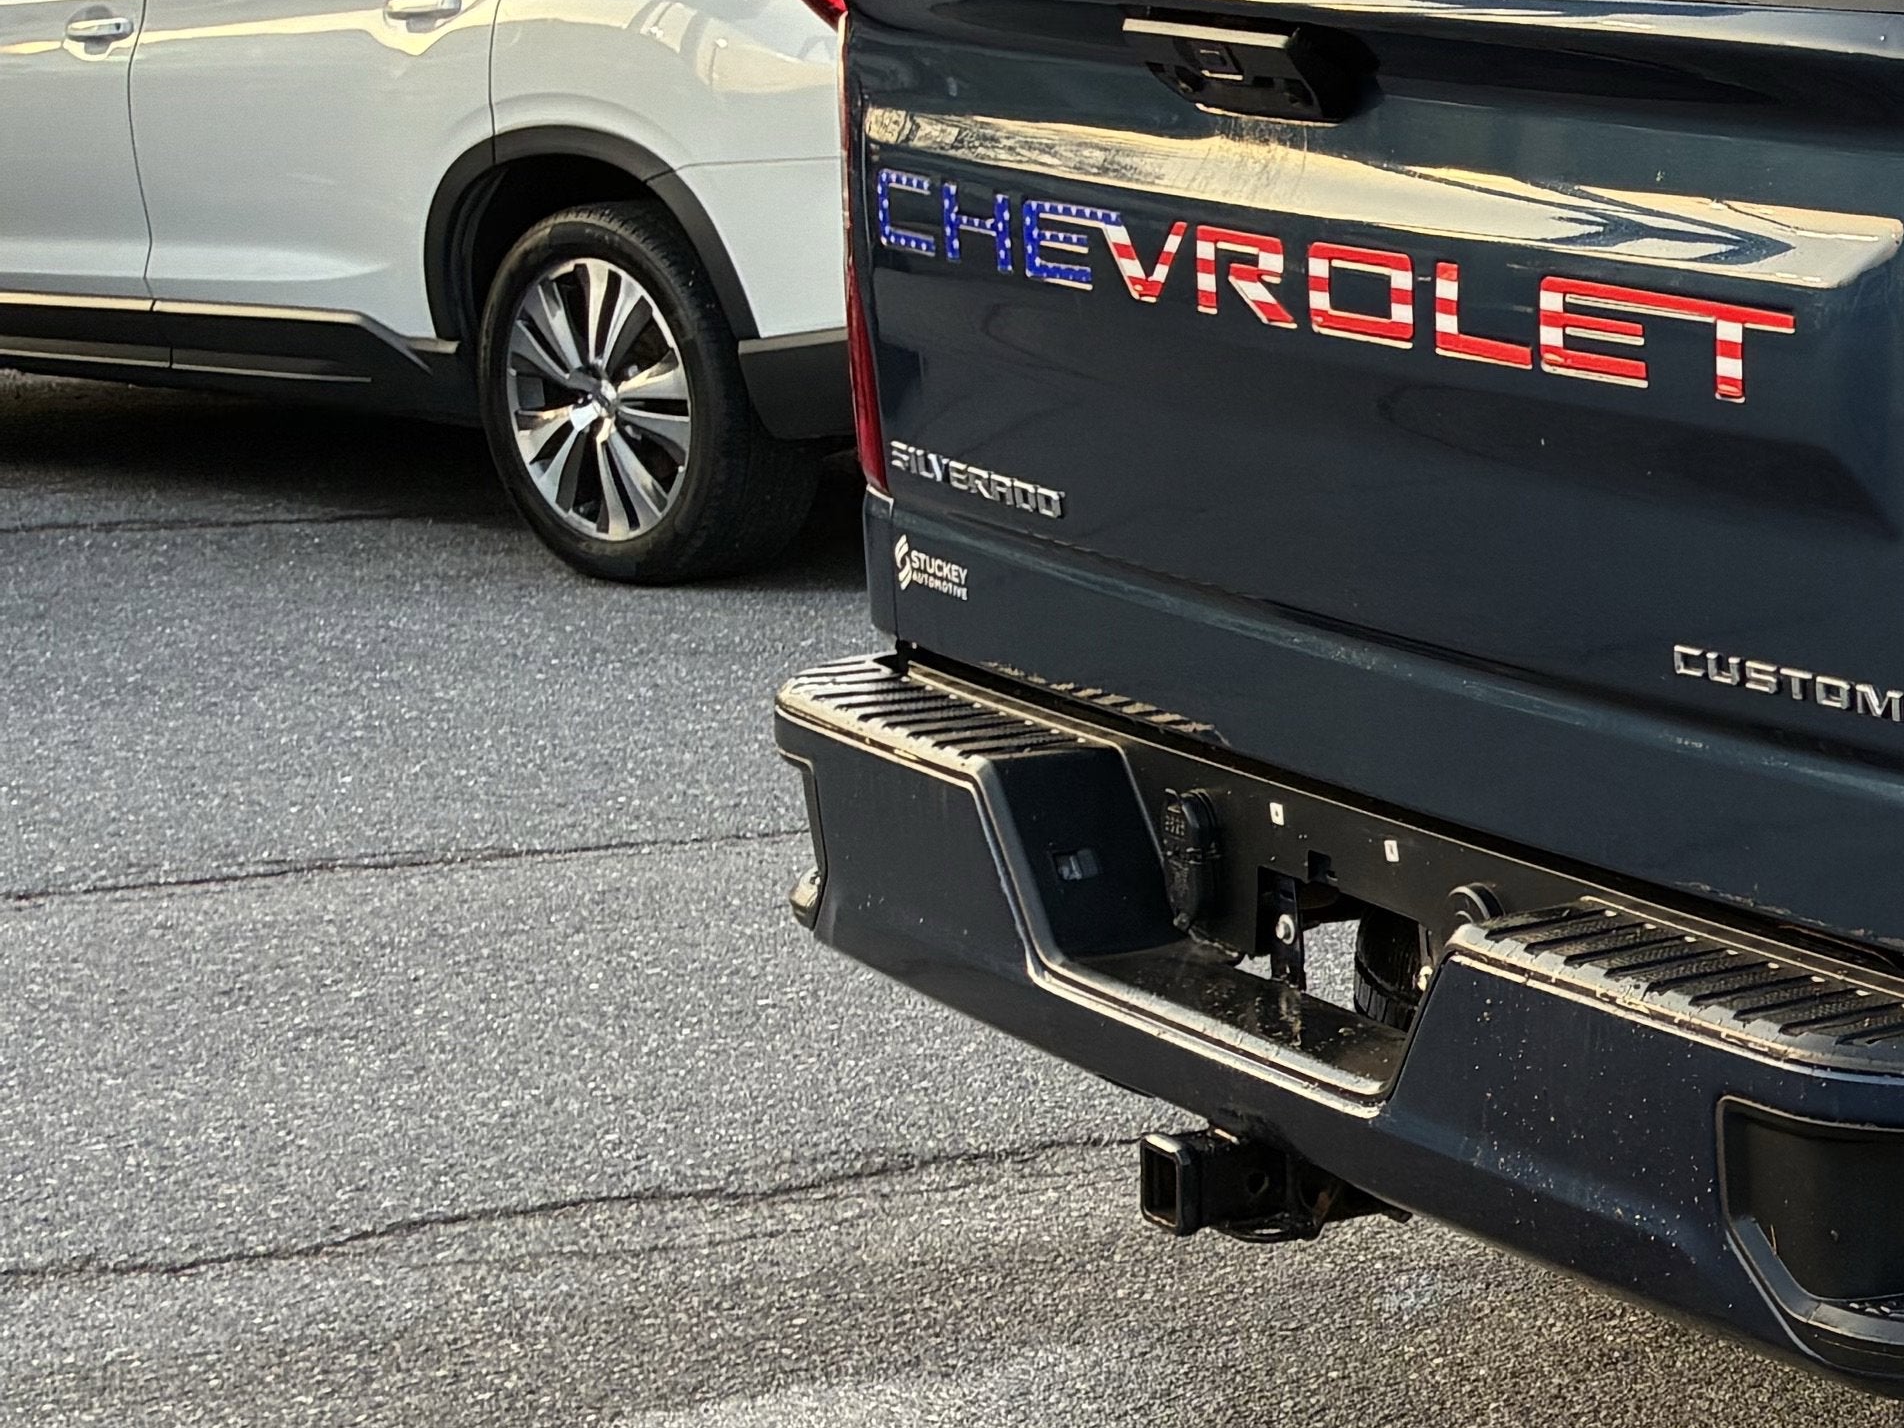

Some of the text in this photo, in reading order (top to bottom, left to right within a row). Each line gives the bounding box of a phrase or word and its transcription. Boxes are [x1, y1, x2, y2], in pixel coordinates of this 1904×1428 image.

[877, 168, 1797, 404] CHEVROLET
[891, 440, 1066, 519] SILVERADO
[910, 549, 968, 586] STUCKEY
[911, 571, 968, 601] AUTOMOTIVE
[1673, 644, 1904, 722] CUSTOM
